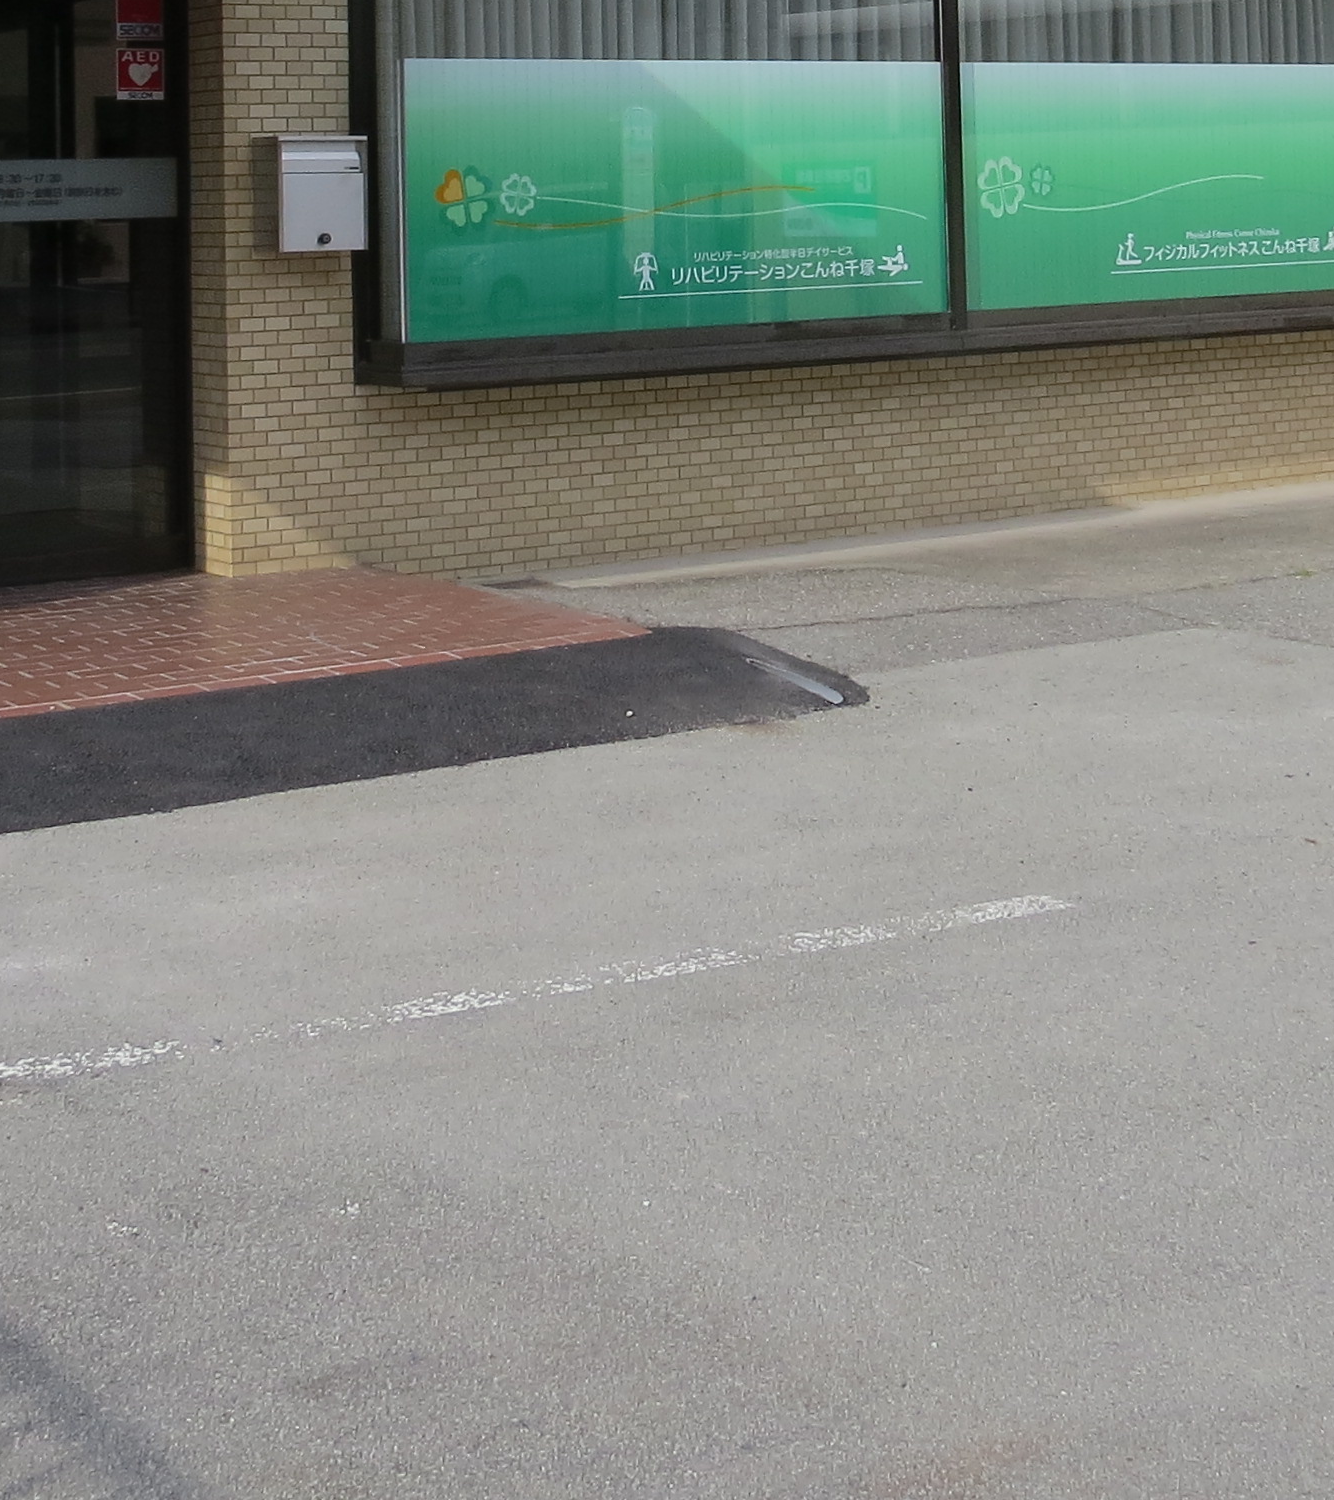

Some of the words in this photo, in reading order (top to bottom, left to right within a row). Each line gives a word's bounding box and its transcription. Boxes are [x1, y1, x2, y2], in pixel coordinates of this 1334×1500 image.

[121, 51, 160, 62] AED
[670, 258, 876, 286] リハビリテーションこんね千塚
